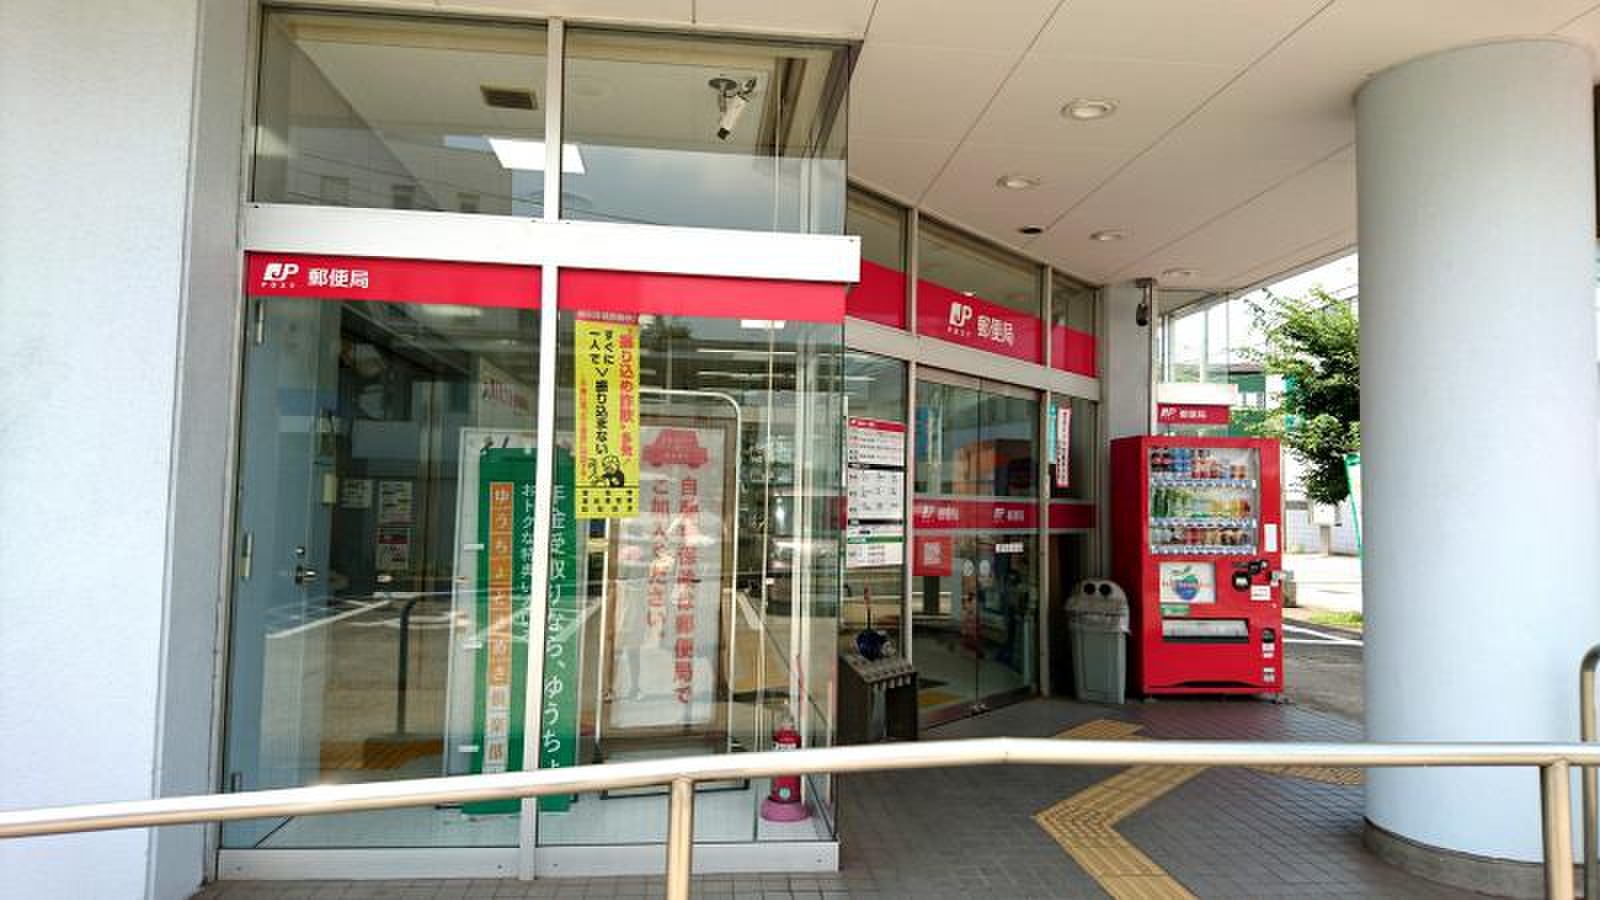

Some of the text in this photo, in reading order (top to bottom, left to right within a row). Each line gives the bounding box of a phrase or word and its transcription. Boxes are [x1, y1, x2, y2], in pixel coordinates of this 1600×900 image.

[307, 268, 369, 289] 郵便局
[976, 314, 1015, 346] 郵便局
